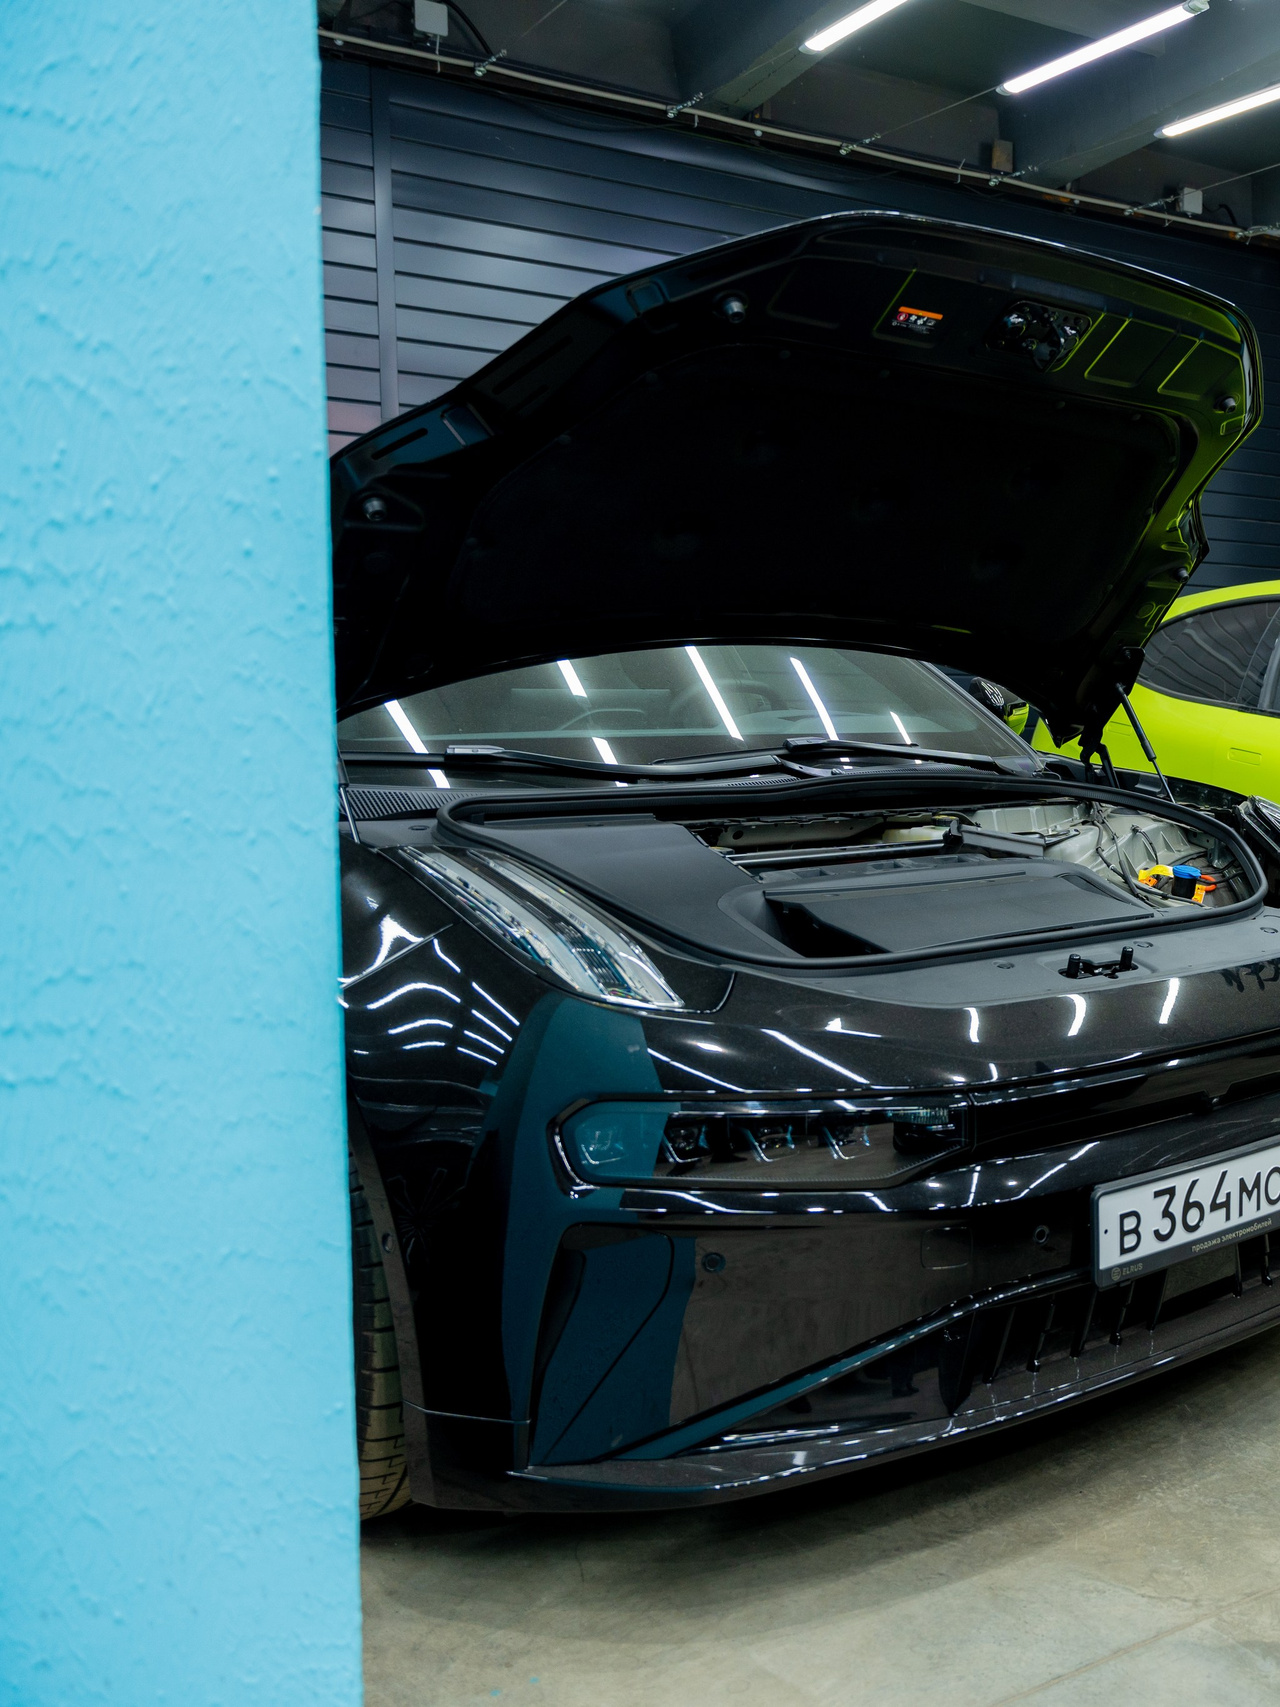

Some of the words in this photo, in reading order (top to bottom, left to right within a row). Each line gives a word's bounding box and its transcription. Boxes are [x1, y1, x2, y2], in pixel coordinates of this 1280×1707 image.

[1191, 1235, 1221, 1253] продажа
[1221, 1218, 1273, 1243] электромобилей
[1122, 1262, 1143, 1276] ELRUS
